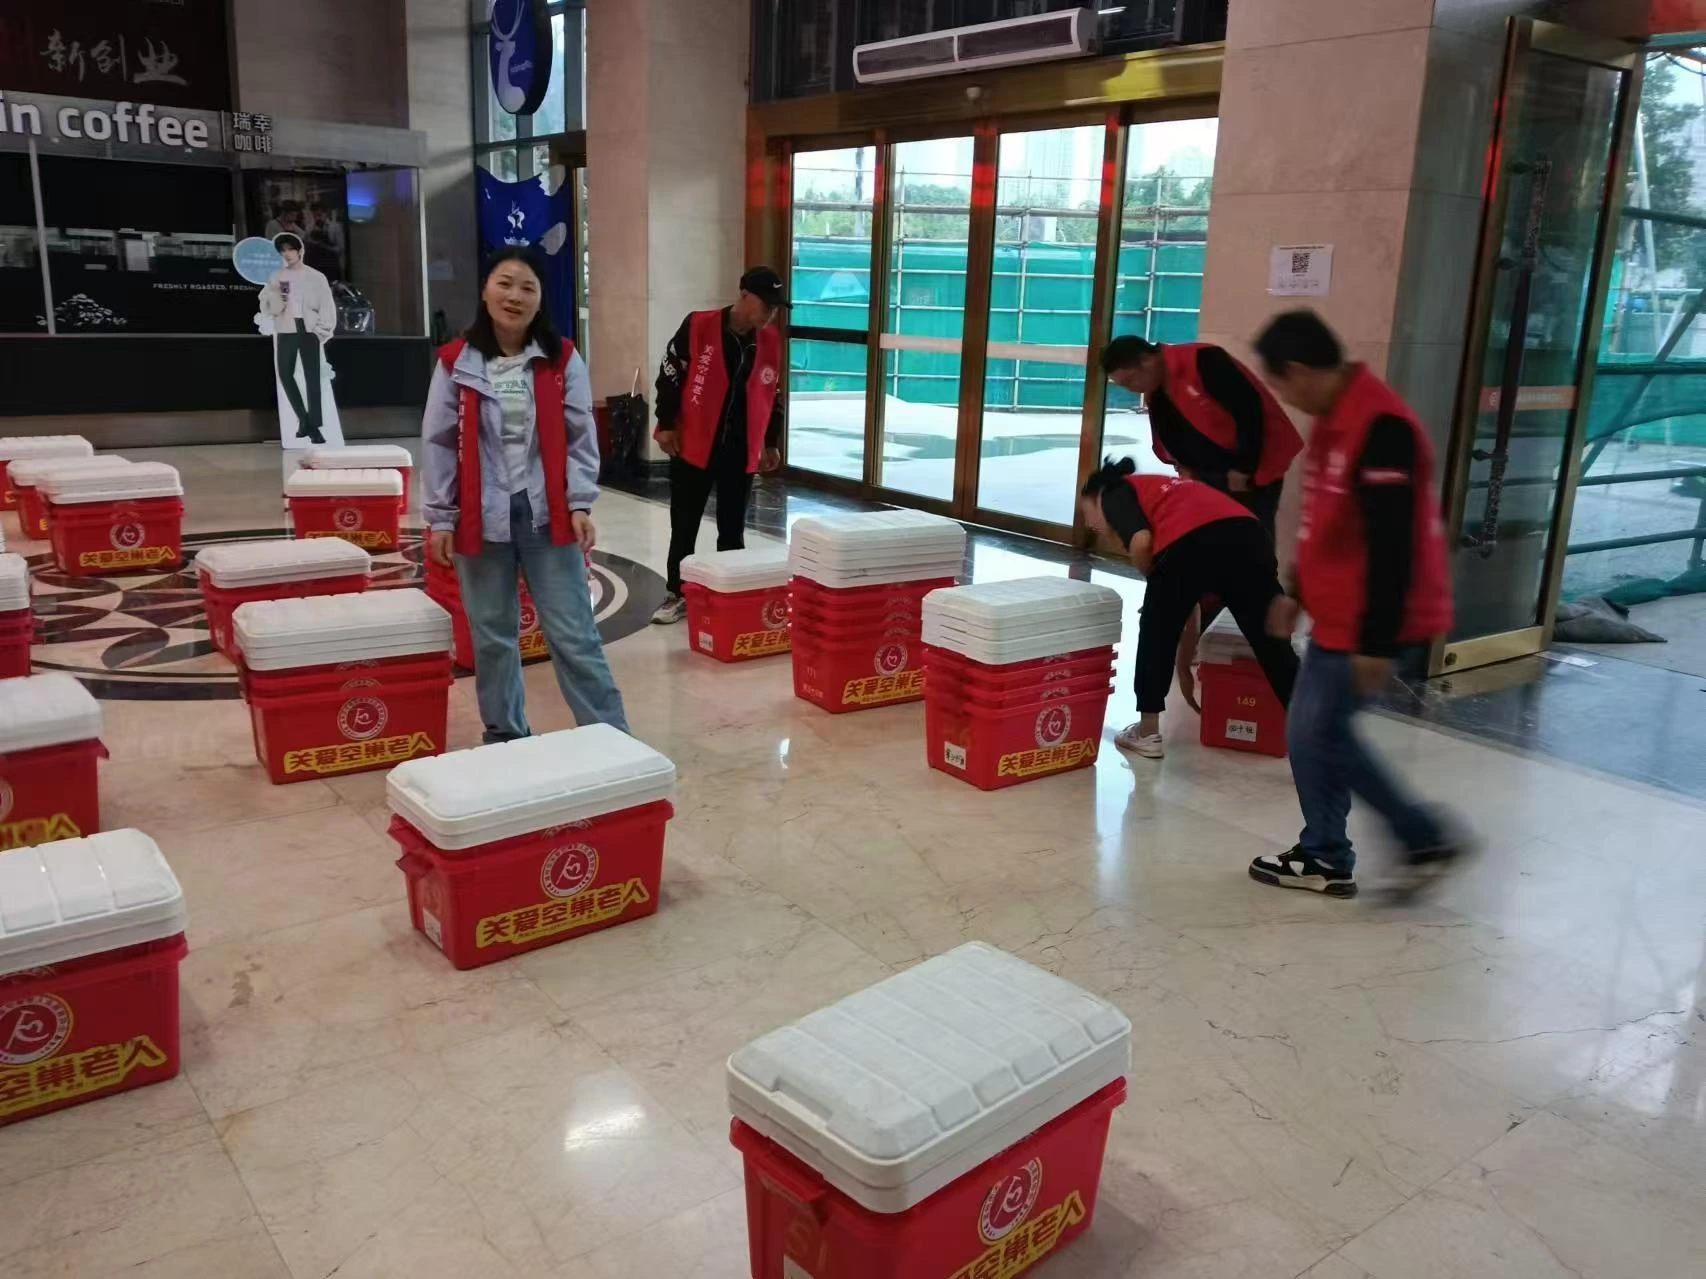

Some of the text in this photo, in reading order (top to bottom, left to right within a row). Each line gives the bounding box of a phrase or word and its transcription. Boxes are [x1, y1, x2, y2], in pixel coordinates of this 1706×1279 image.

[58, 101, 209, 148] coffee
[233, 112, 271, 132] 瑞幸
[234, 134, 272, 153] 咖啡
[845, 671, 922, 699] 关爱空巢老
[289, 735, 434, 771] 关爱空巢老人
[1001, 741, 1096, 773] 关爱空巢老人
[482, 880, 647, 942] 关爱空巢老人
